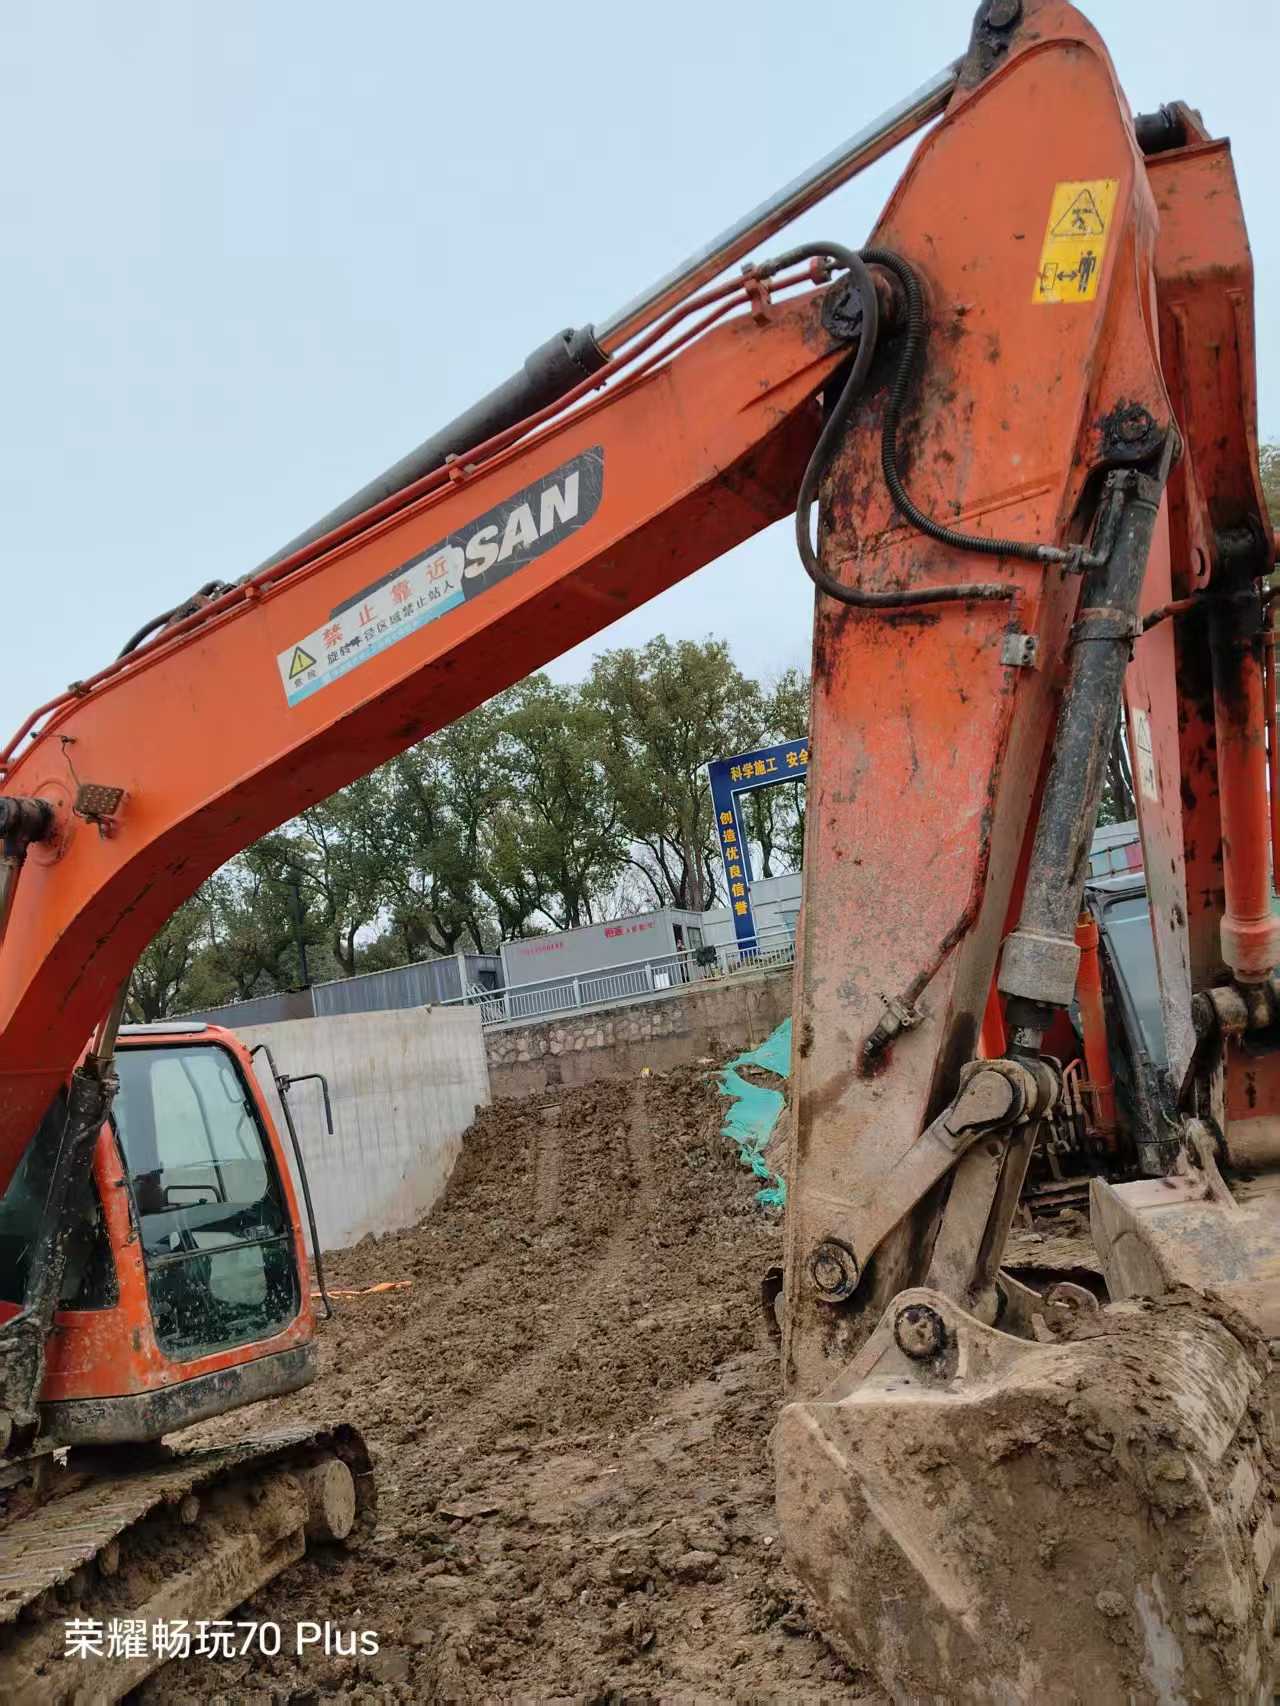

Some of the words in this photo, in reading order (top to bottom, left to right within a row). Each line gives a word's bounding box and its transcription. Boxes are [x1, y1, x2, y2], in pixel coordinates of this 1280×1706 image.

[322, 556, 449, 649] 禁止靠近
[729, 757, 778, 783] 科学施工
[719, 810, 748, 916] 创造优良信誉
